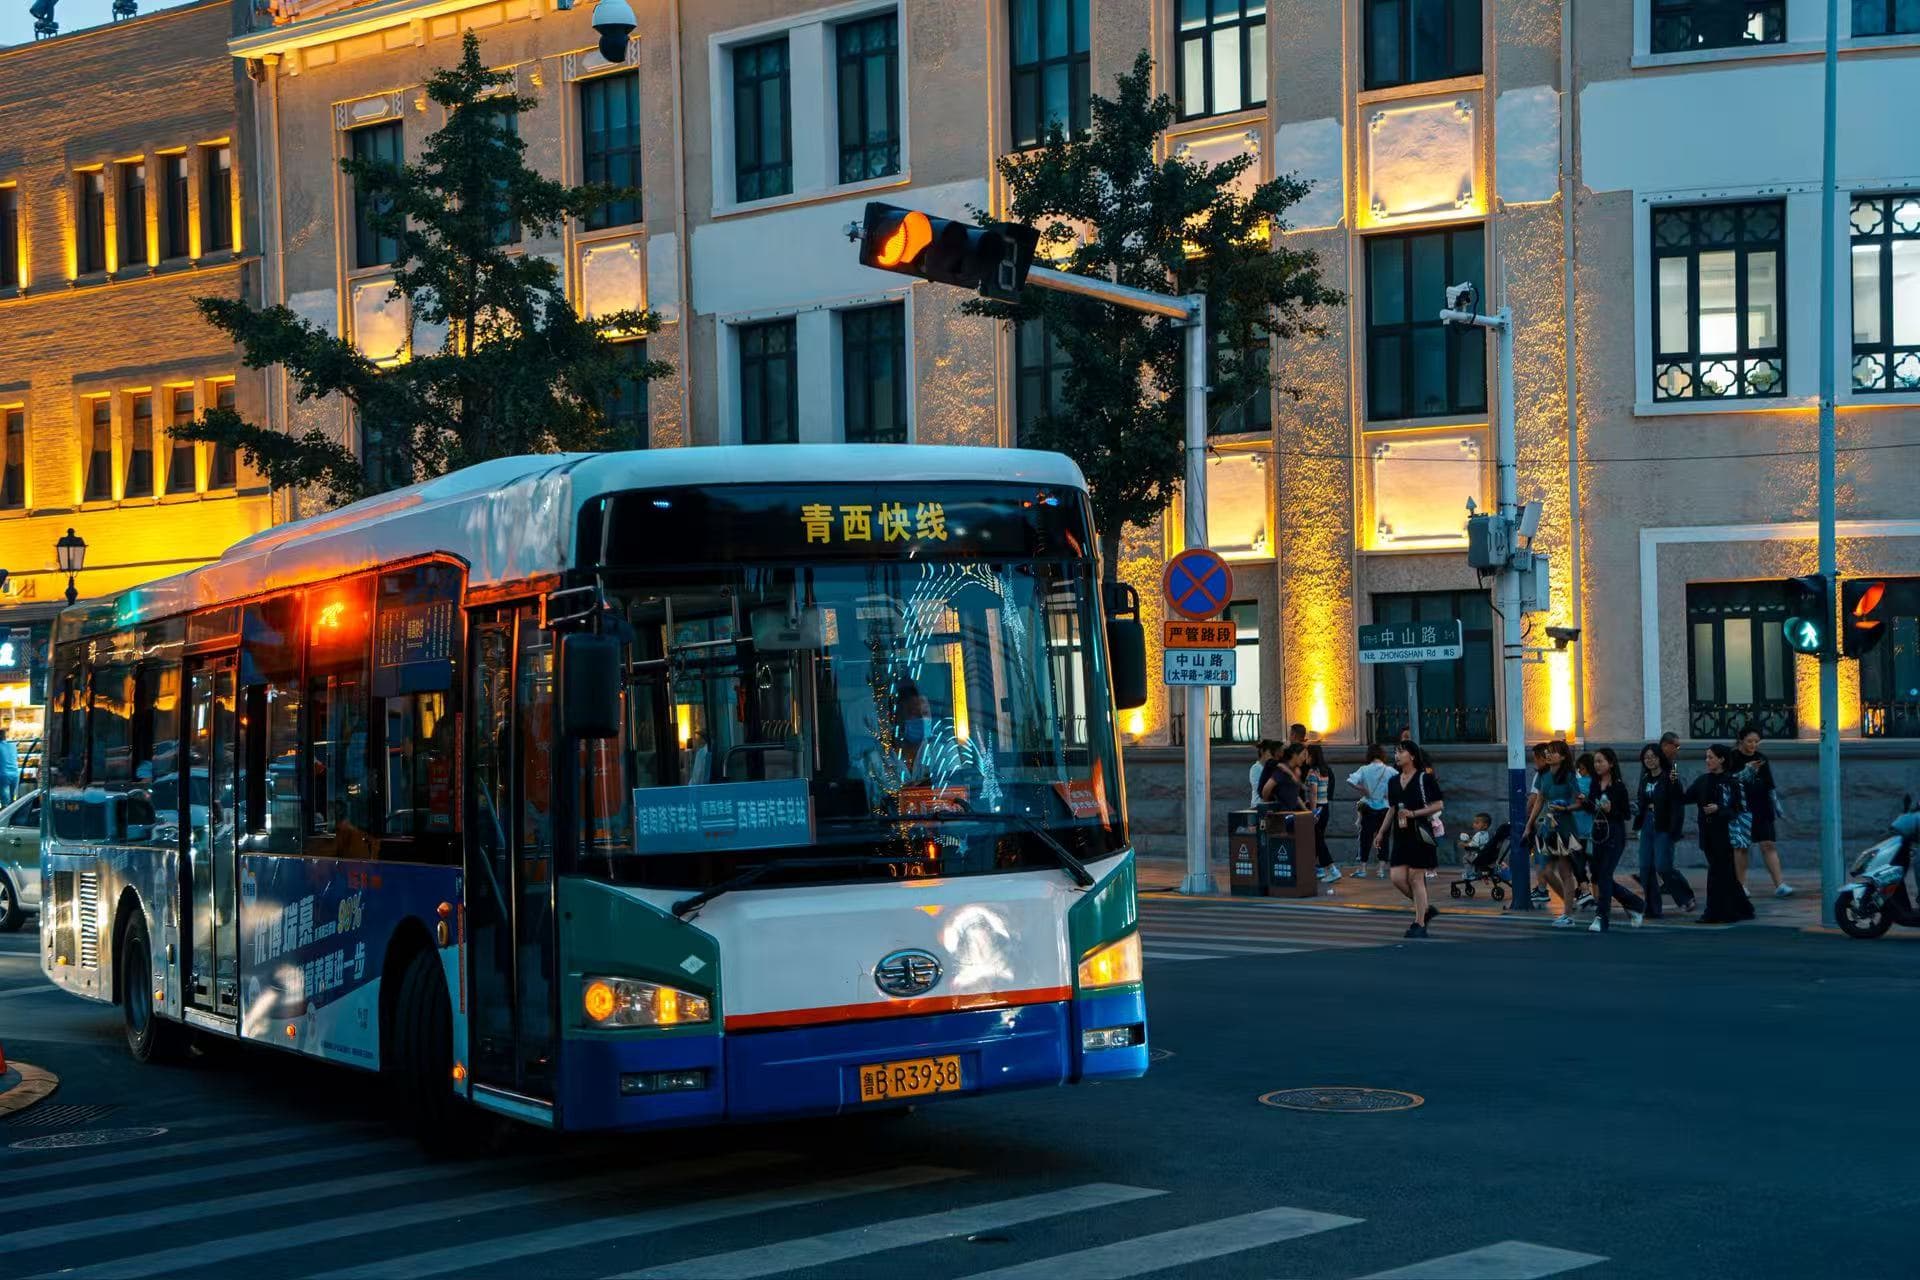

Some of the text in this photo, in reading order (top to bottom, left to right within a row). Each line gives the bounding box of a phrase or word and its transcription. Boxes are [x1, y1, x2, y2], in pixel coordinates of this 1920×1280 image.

[801, 502, 948, 543] 青西快线
[1169, 626, 1231, 642] 严管路段
[1381, 626, 1437, 647] 中山路
[1176, 653, 1224, 667] 中山路
[1380, 649, 1424, 660] ZHONGSHAN
[1427, 649, 1436, 657] Rd
